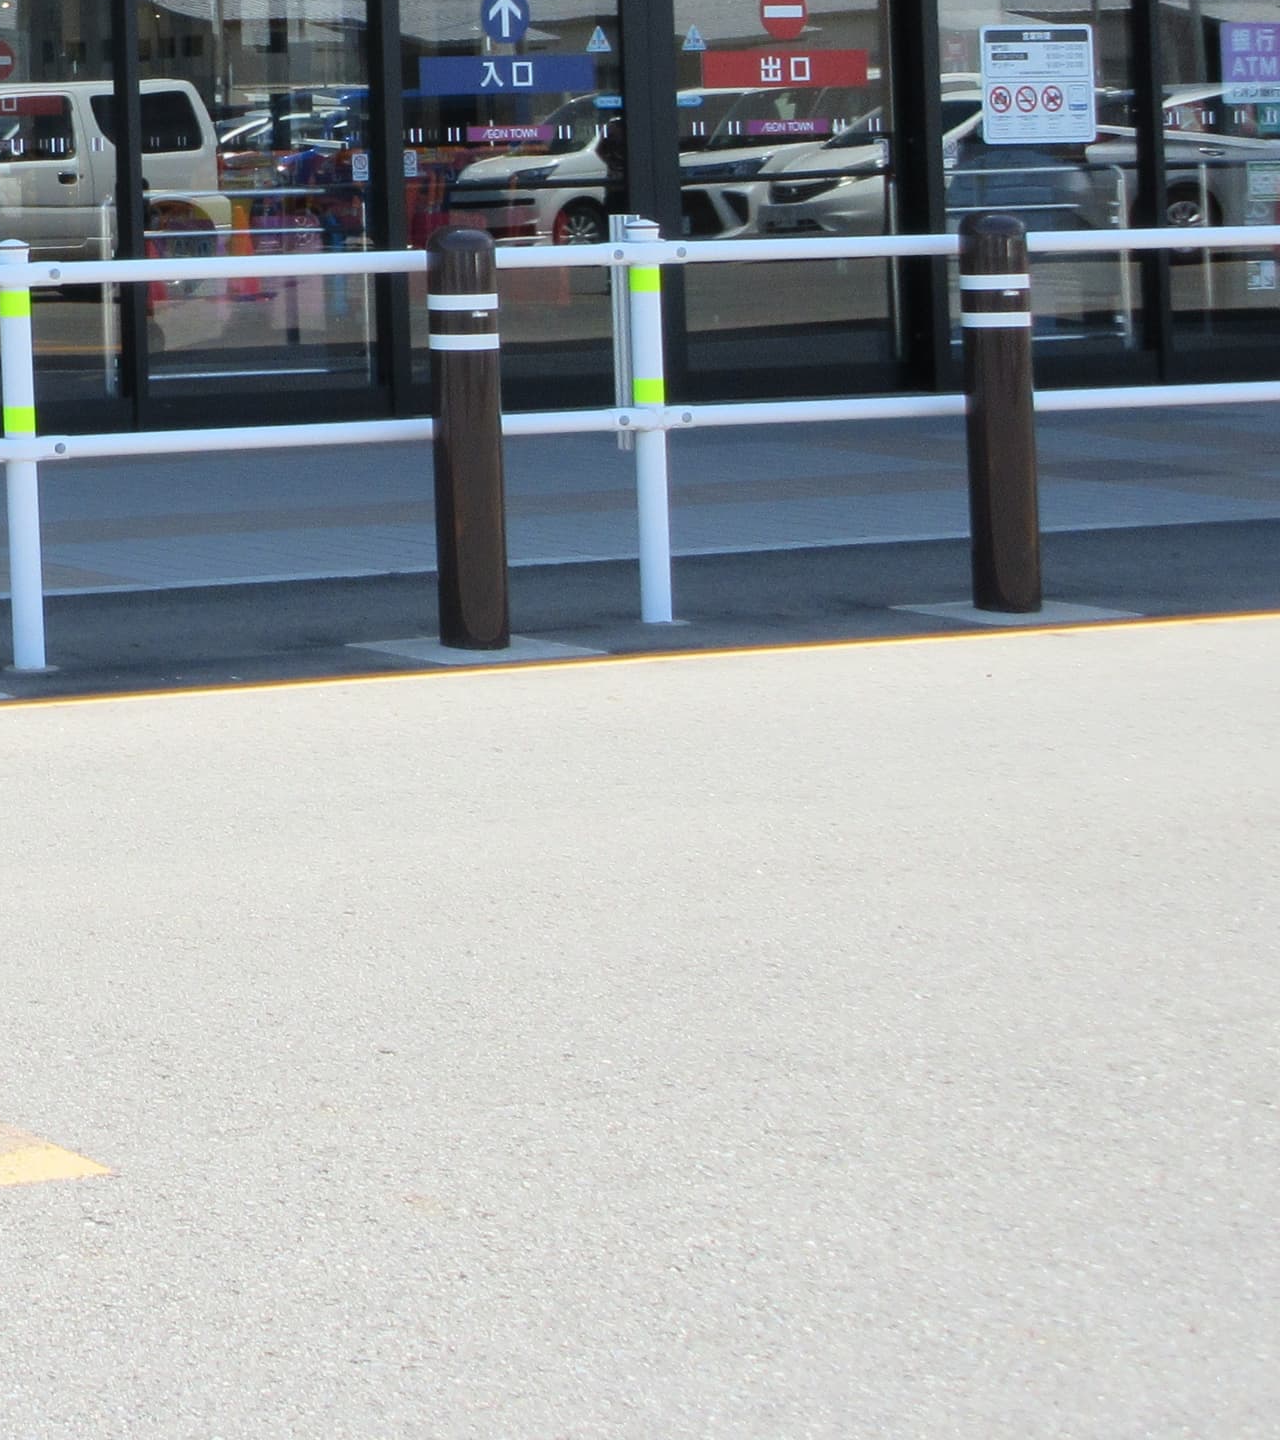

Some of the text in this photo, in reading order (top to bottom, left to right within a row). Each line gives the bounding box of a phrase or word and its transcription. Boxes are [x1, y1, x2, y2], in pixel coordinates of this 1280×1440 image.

[480, 61, 534, 88] 入口
[760, 56, 811, 83] 出口
[1231, 56, 1278, 77] ATM
[510, 127, 538, 138] TOWN
[788, 121, 814, 133] TOWN
